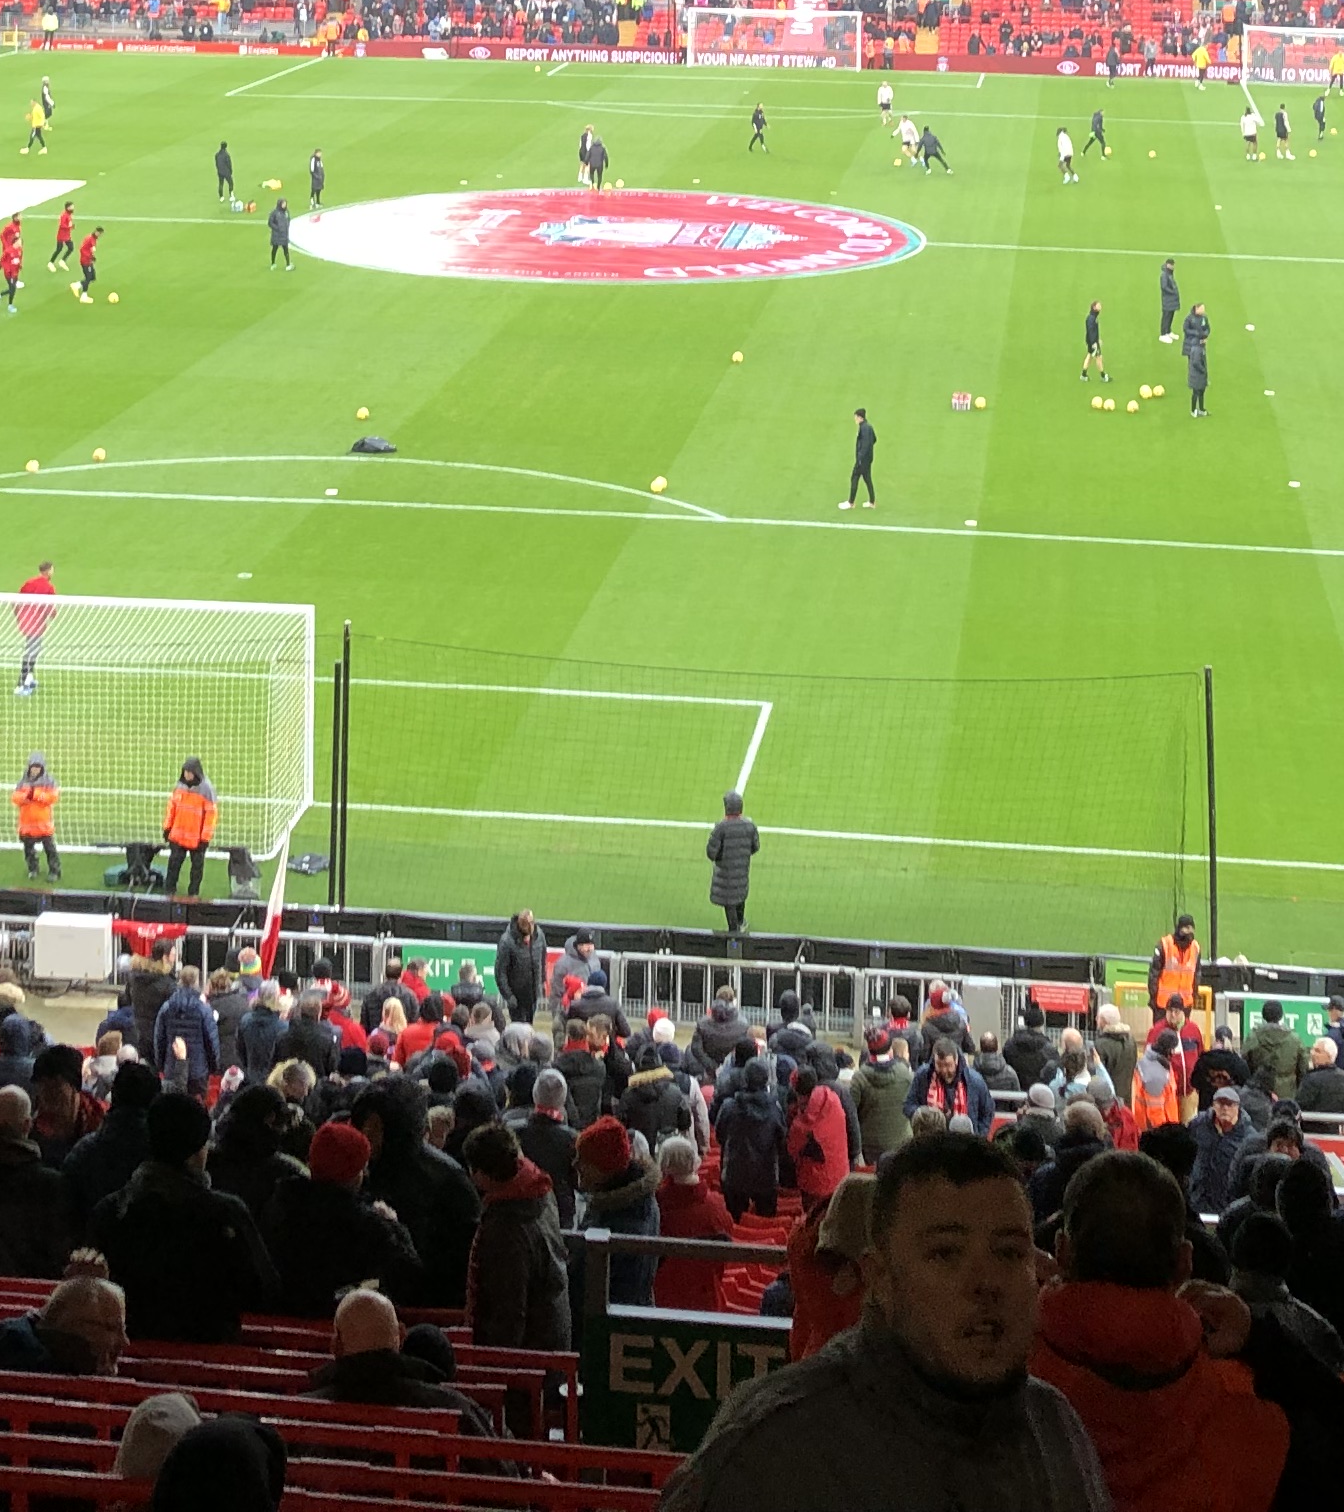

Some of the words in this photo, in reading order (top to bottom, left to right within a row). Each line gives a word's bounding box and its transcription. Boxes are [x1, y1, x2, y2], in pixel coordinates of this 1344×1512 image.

[505, 47, 549, 61] REPORT
[551, 49, 609, 63] ANYTHING
[696, 52, 727, 65] YOUR
[729, 53, 781, 67] NEAREST
[407, 956, 454, 978] XIT
[1249, 1011, 1300, 1030] ET
[609, 1333, 787, 1401] EXIT
